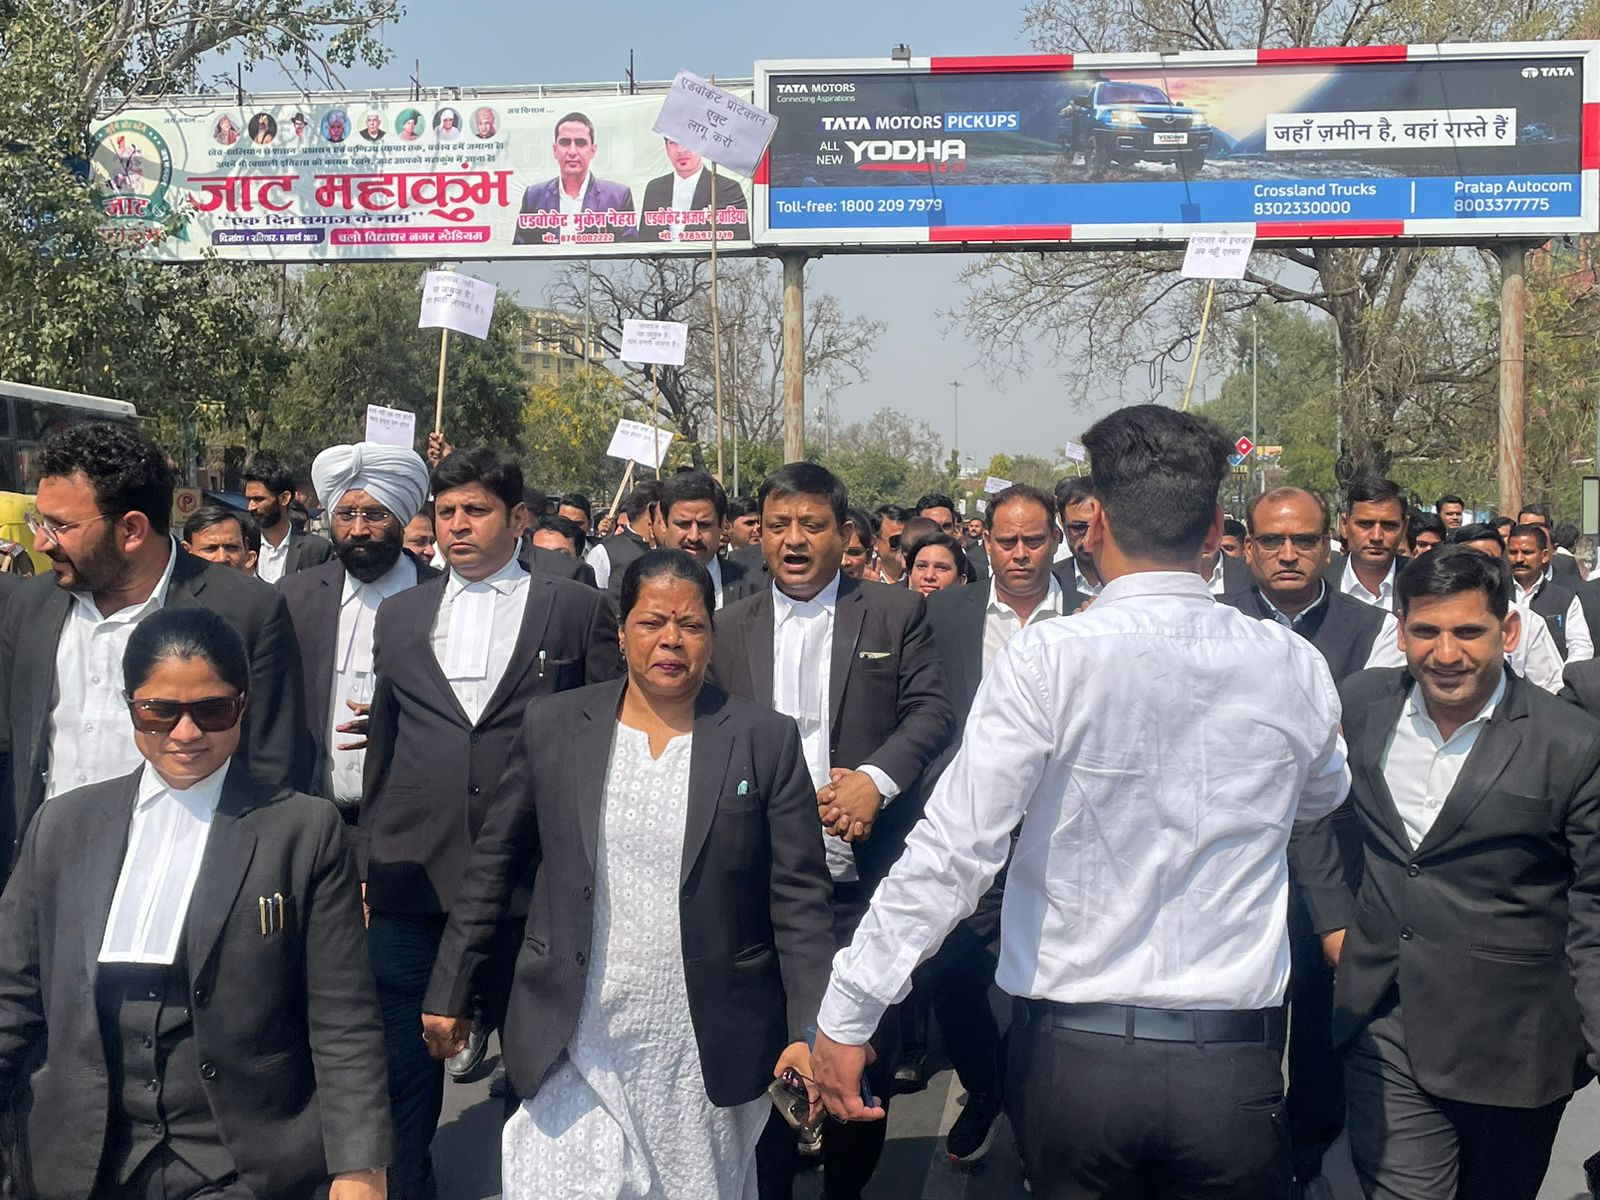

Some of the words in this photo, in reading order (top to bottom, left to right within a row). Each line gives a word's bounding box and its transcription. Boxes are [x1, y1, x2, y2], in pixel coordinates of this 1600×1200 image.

[1540, 67, 1574, 77] TATA
[777, 83, 809, 94] TATA
[811, 83, 856, 93] MOTORS
[777, 95, 816, 105] Connecting
[817, 95, 856, 104] Aspirations
[822, 116, 872, 131] TATA
[875, 115, 943, 130] MOTORS
[947, 113, 1017, 129] PICKUPS
[1273, 119, 1315, 143] जहाँ
[1317, 119, 1373, 143] ज़मीन
[1377, 117, 1397, 143] है,
[1403, 119, 1439, 140] वहां
[1445, 116, 1489, 140] रास्ते
[1493, 115, 1509, 139] हैं
[819, 141, 840, 152] ALL
[843, 138, 966, 164] YODHA
[816, 155, 843, 166] NEW
[187, 174, 301, 213] जाट
[314, 162, 514, 222] महाकुंभ
[1254, 183, 1326, 199] Crossland
[1328, 183, 1377, 197] Trucks
[1454, 181, 1503, 197] Pratap
[1506, 180, 1573, 194] Autocom
[776, 200, 837, 213] Toll-free:
[840, 199, 875, 213] 1800
[877, 199, 905, 213] 209
[907, 198, 943, 212] 7979
[1253, 201, 1352, 216] 8302330000
[1454, 198, 1551, 213] 8003377775
[264, 213, 295, 226] दिन
[301, 213, 351, 226] समाज
[355, 212, 374, 225] के
[519, 208, 569, 229] एडवोकेट
[573, 208, 606, 232] मुकेश
[607, 208, 637, 228] नेहरा
[645, 207, 681, 226] एडवोकेट
[364, 230, 407, 244] विद्याधर
[408, 230, 435, 243] नगर
[437, 228, 483, 243] स्टेडियम
